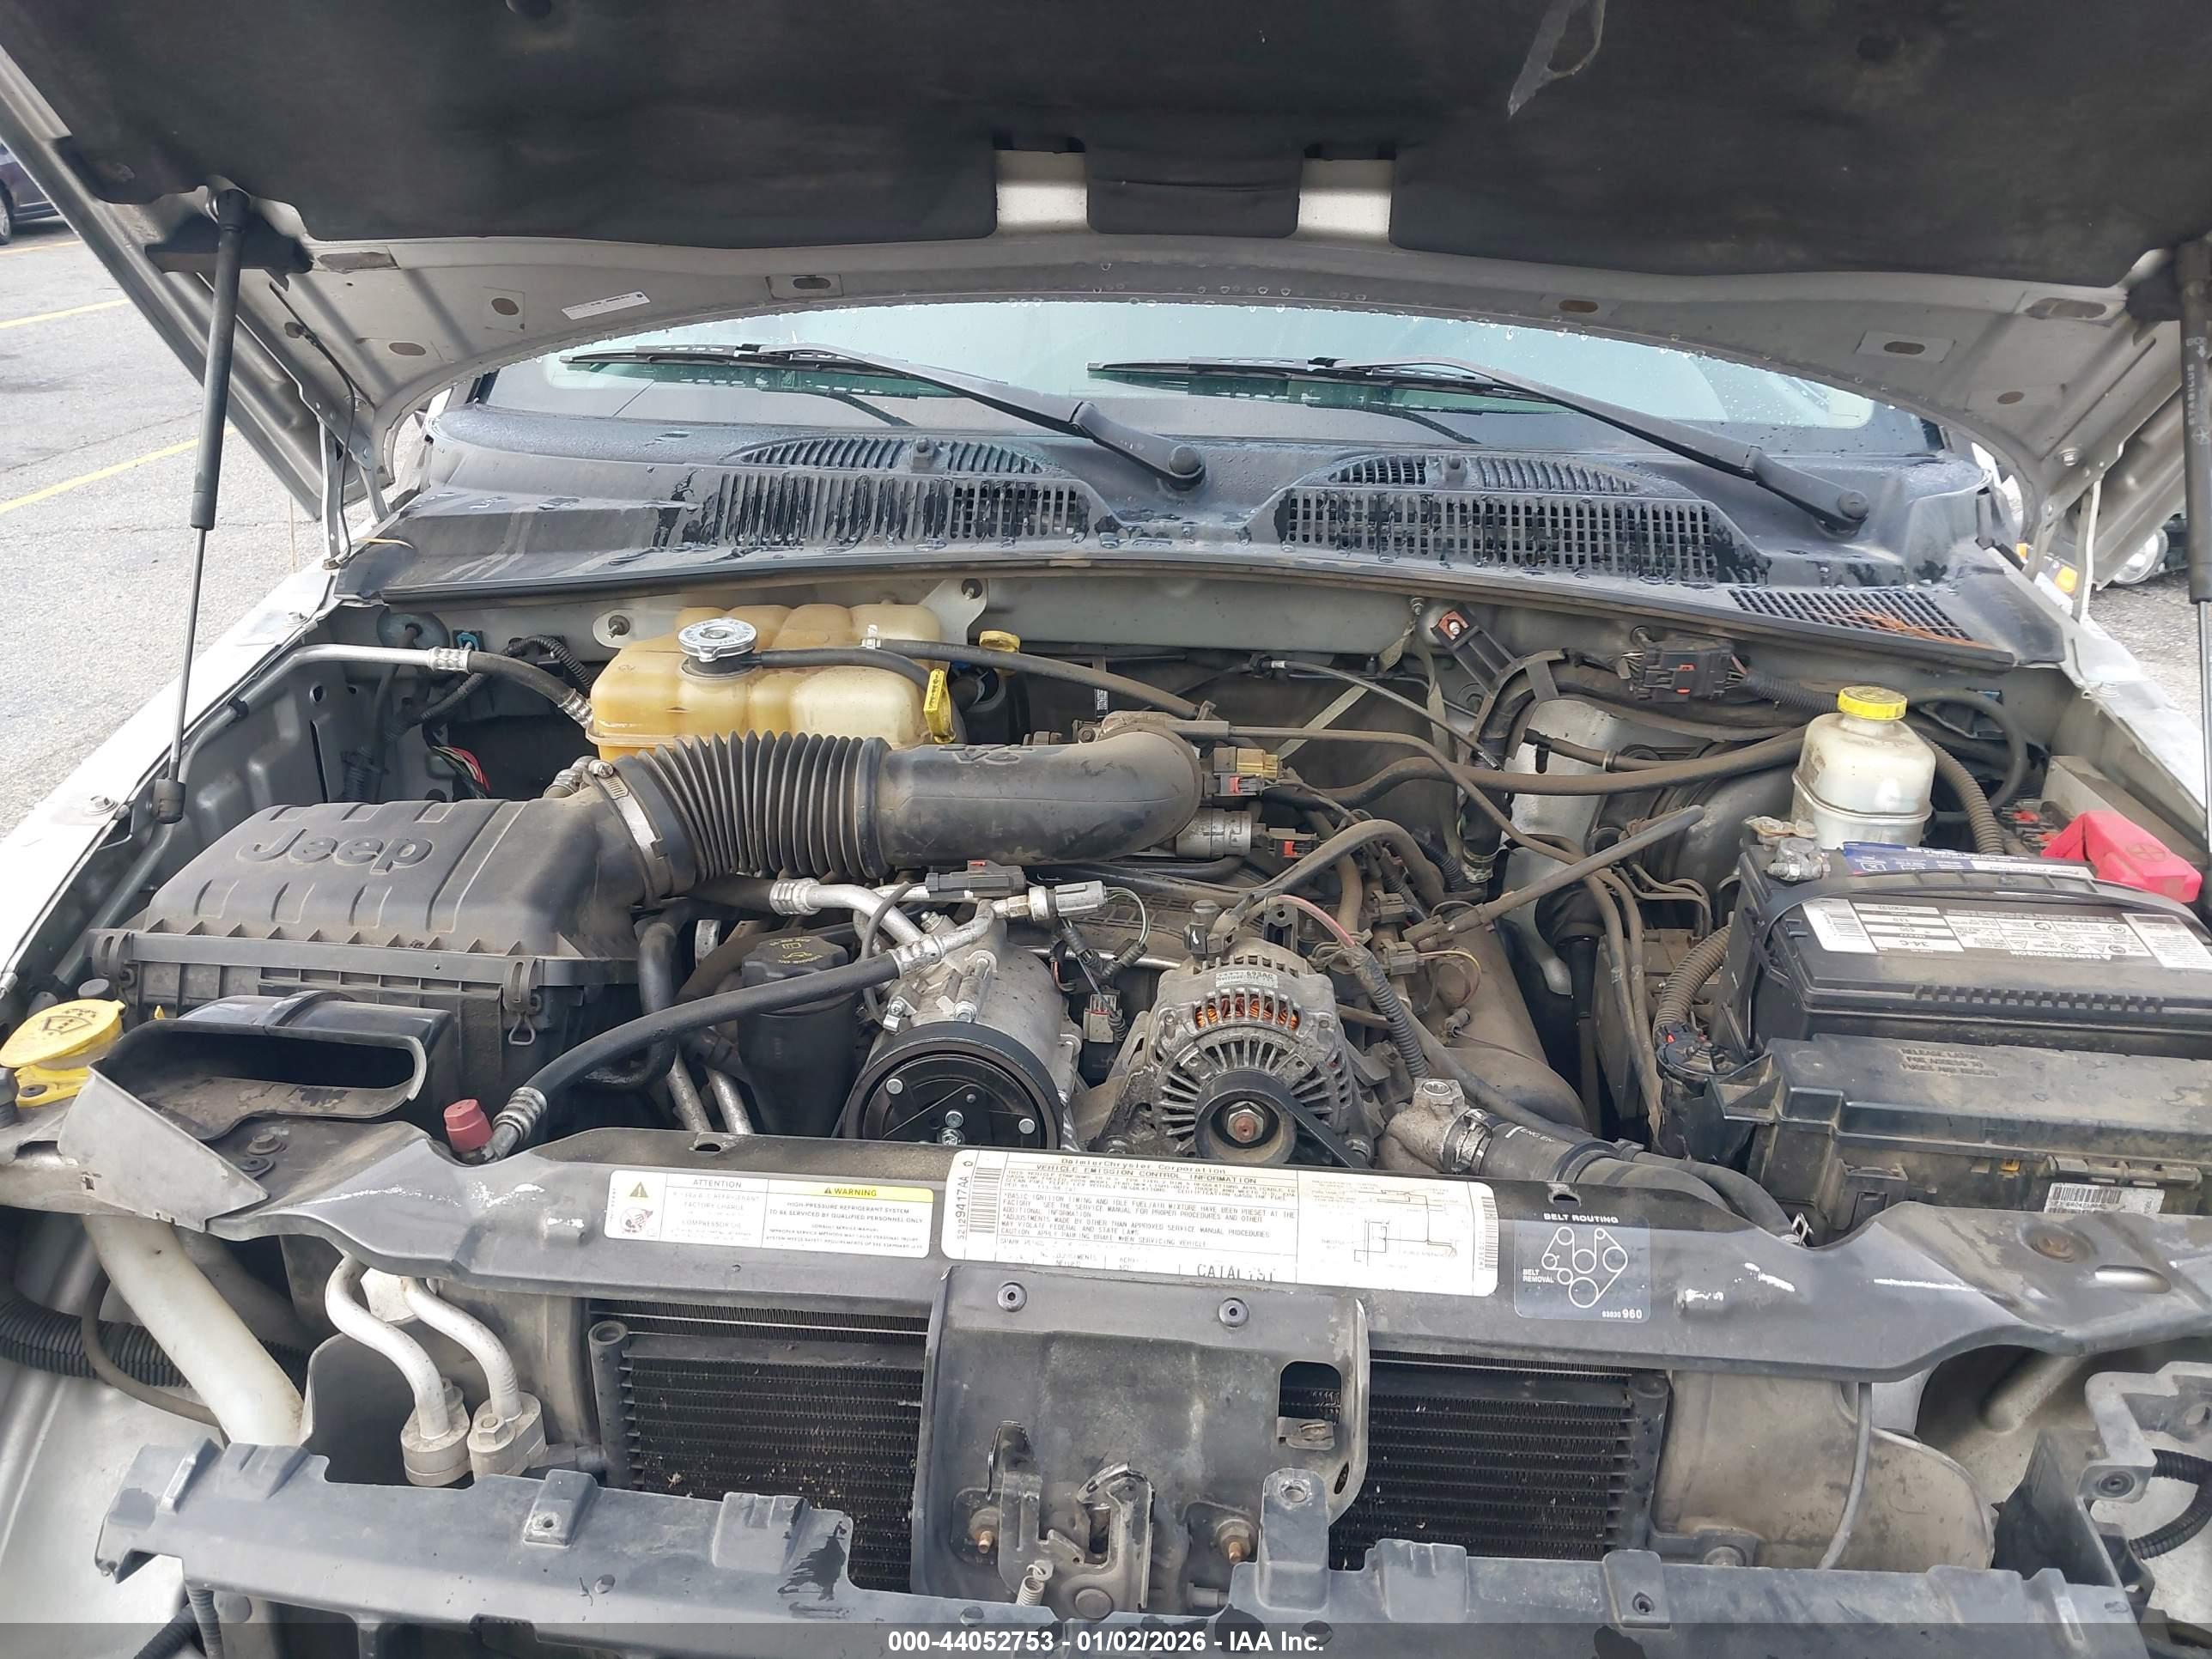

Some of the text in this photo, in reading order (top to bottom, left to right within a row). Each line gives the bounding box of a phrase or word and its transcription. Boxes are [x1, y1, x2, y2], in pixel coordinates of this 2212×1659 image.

[236, 827, 435, 876] Jeep
[1061, 1158, 1225, 1175] DaimlerChrysler Corporation
[1036, 1164, 1077, 1172] VEHICLE
[1084, 1167, 1133, 1176] EMISSION
[1189, 1174, 1256, 1183] INFORMATION
[692, 1178, 742, 1188] ATTENTION
[834, 1188, 877, 1196] WARNING
[684, 1200, 714, 1209] FACTORY
[787, 1200, 838, 1209] HIGH-PRESSURE
[839, 1204, 883, 1212] REFRIGERANT
[1003, 1206, 1042, 1214] ADDITIONAL
[1132, 1200, 1165, 1209] FUEL/AIR
[1168, 1203, 1196, 1212] MIXTURE
[1074, 1203, 1103, 1212] SERVICE
[1180, 1211, 1221, 1219] PROCEDURES
[682, 1218, 729, 1228] COMPRESSOR
[1544, 1212, 1620, 1223] BELT ROUTING
